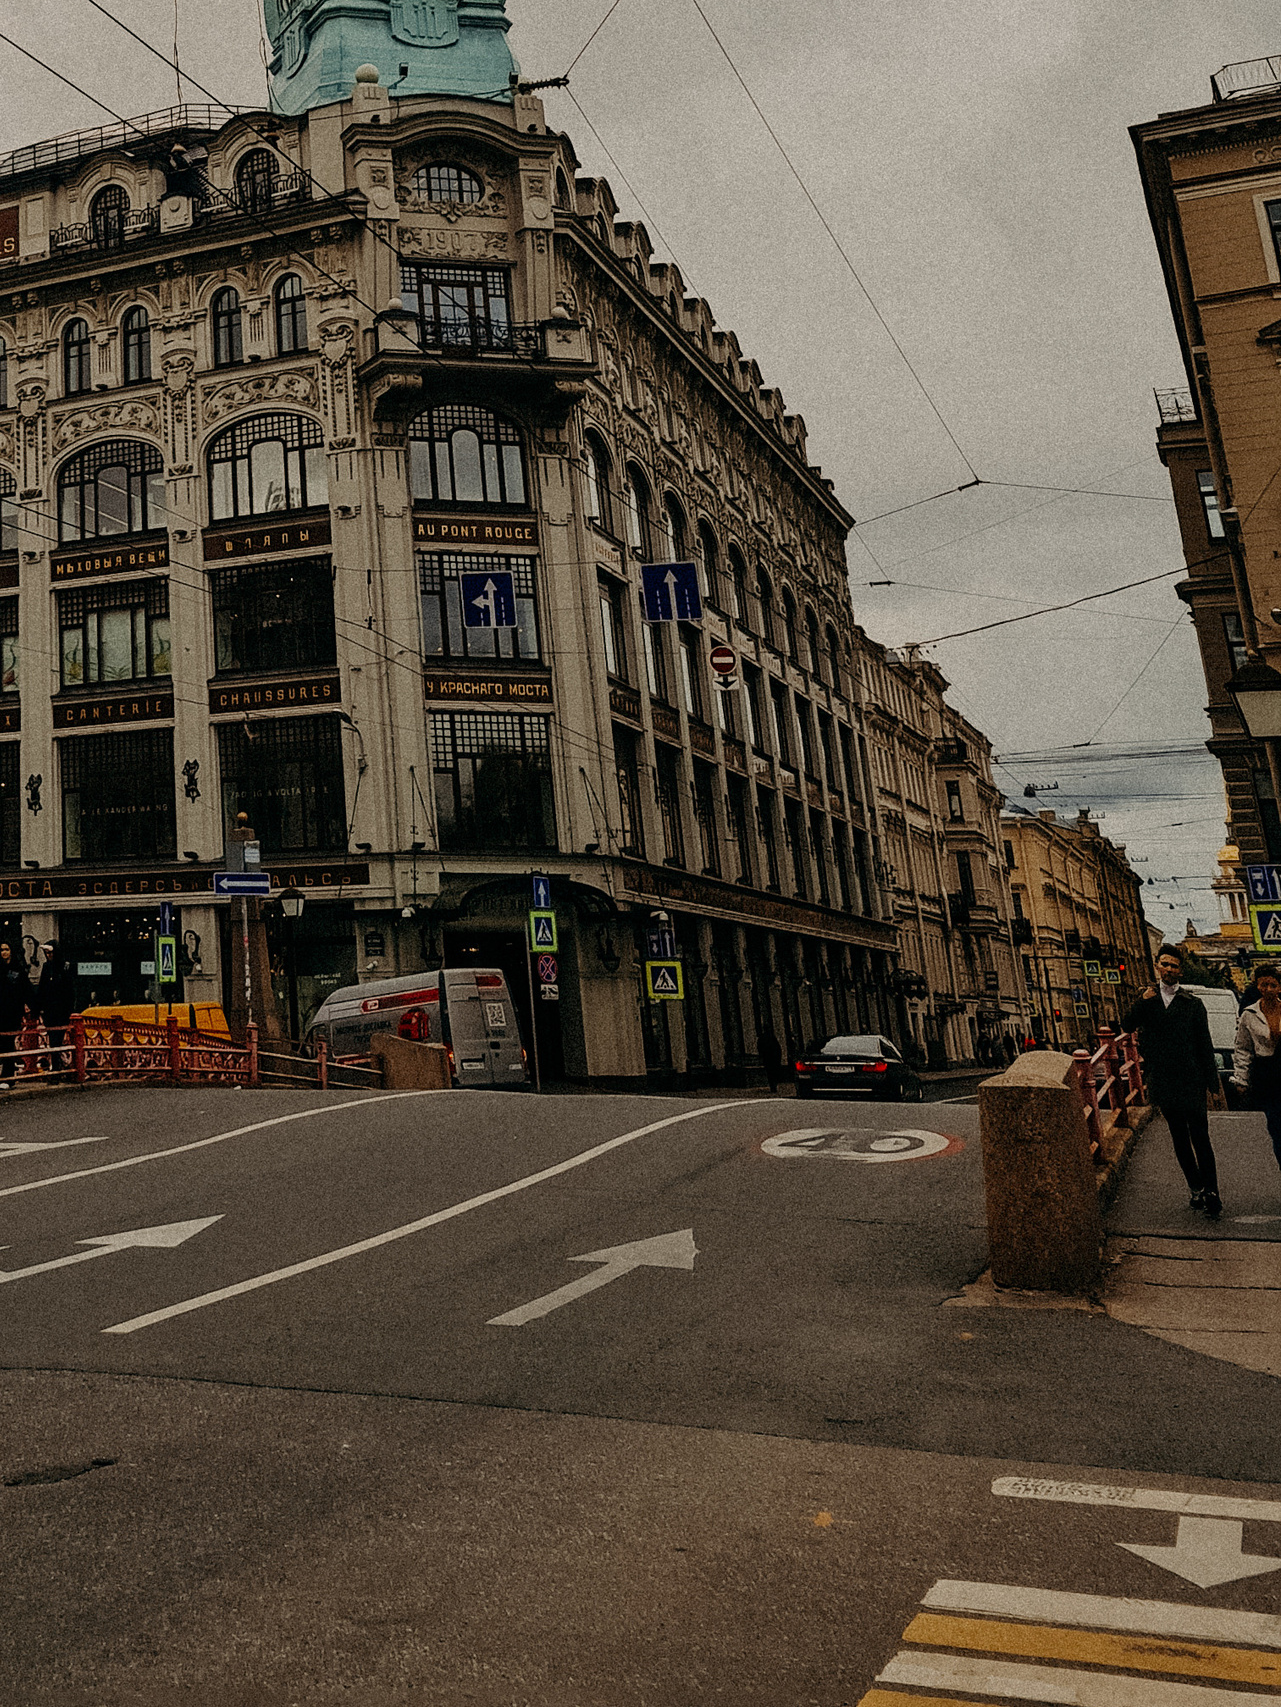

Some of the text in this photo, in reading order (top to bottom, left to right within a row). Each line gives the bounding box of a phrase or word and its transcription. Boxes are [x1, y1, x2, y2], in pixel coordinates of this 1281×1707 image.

[417, 523, 533, 540] AU PONT ROUGE
[225, 529, 310, 552] ШЛЯПЫ
[129, 549, 166, 565] ВЕЩИ
[219, 684, 331, 707] CHAUSSURES
[426, 680, 549, 696] У КРАСНАГО МОСТА
[78, 878, 183, 896] ЭСДЕРСЪ
